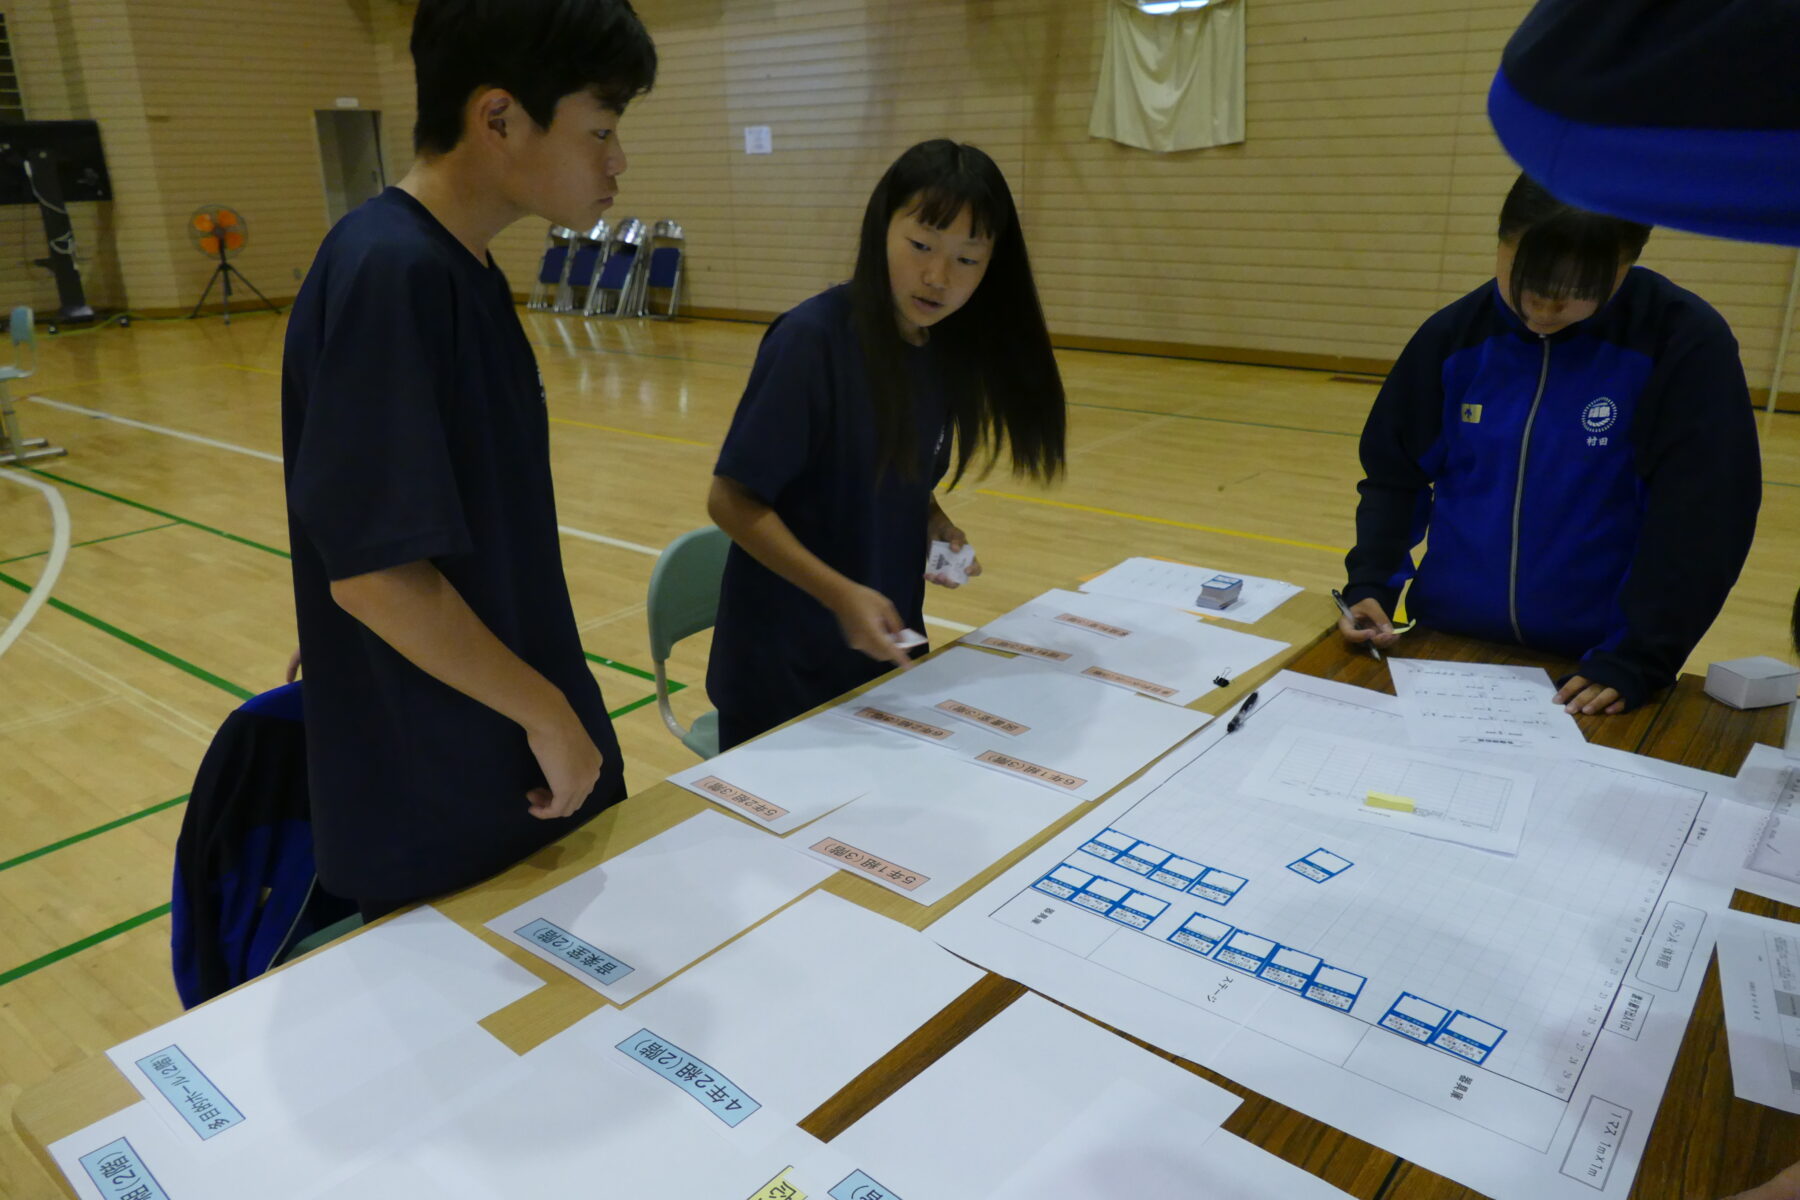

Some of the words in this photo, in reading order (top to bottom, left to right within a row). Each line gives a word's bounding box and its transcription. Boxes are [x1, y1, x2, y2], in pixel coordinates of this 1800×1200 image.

[988, 754, 1076, 786] 6年1組(3階)
[704, 781, 778, 817] 5年2組(3階)
[824, 843, 917, 885] 5年1組(3階)
[532, 927, 618, 976] 音楽室(2階)
[1207, 976, 1234, 1003] ステージ
[150, 1054, 230, 1130] 多目的ホール(2階)
[634, 1040, 743, 1112] 4年2組(2階)
[1450, 1074, 1473, 1101] 器具庫
